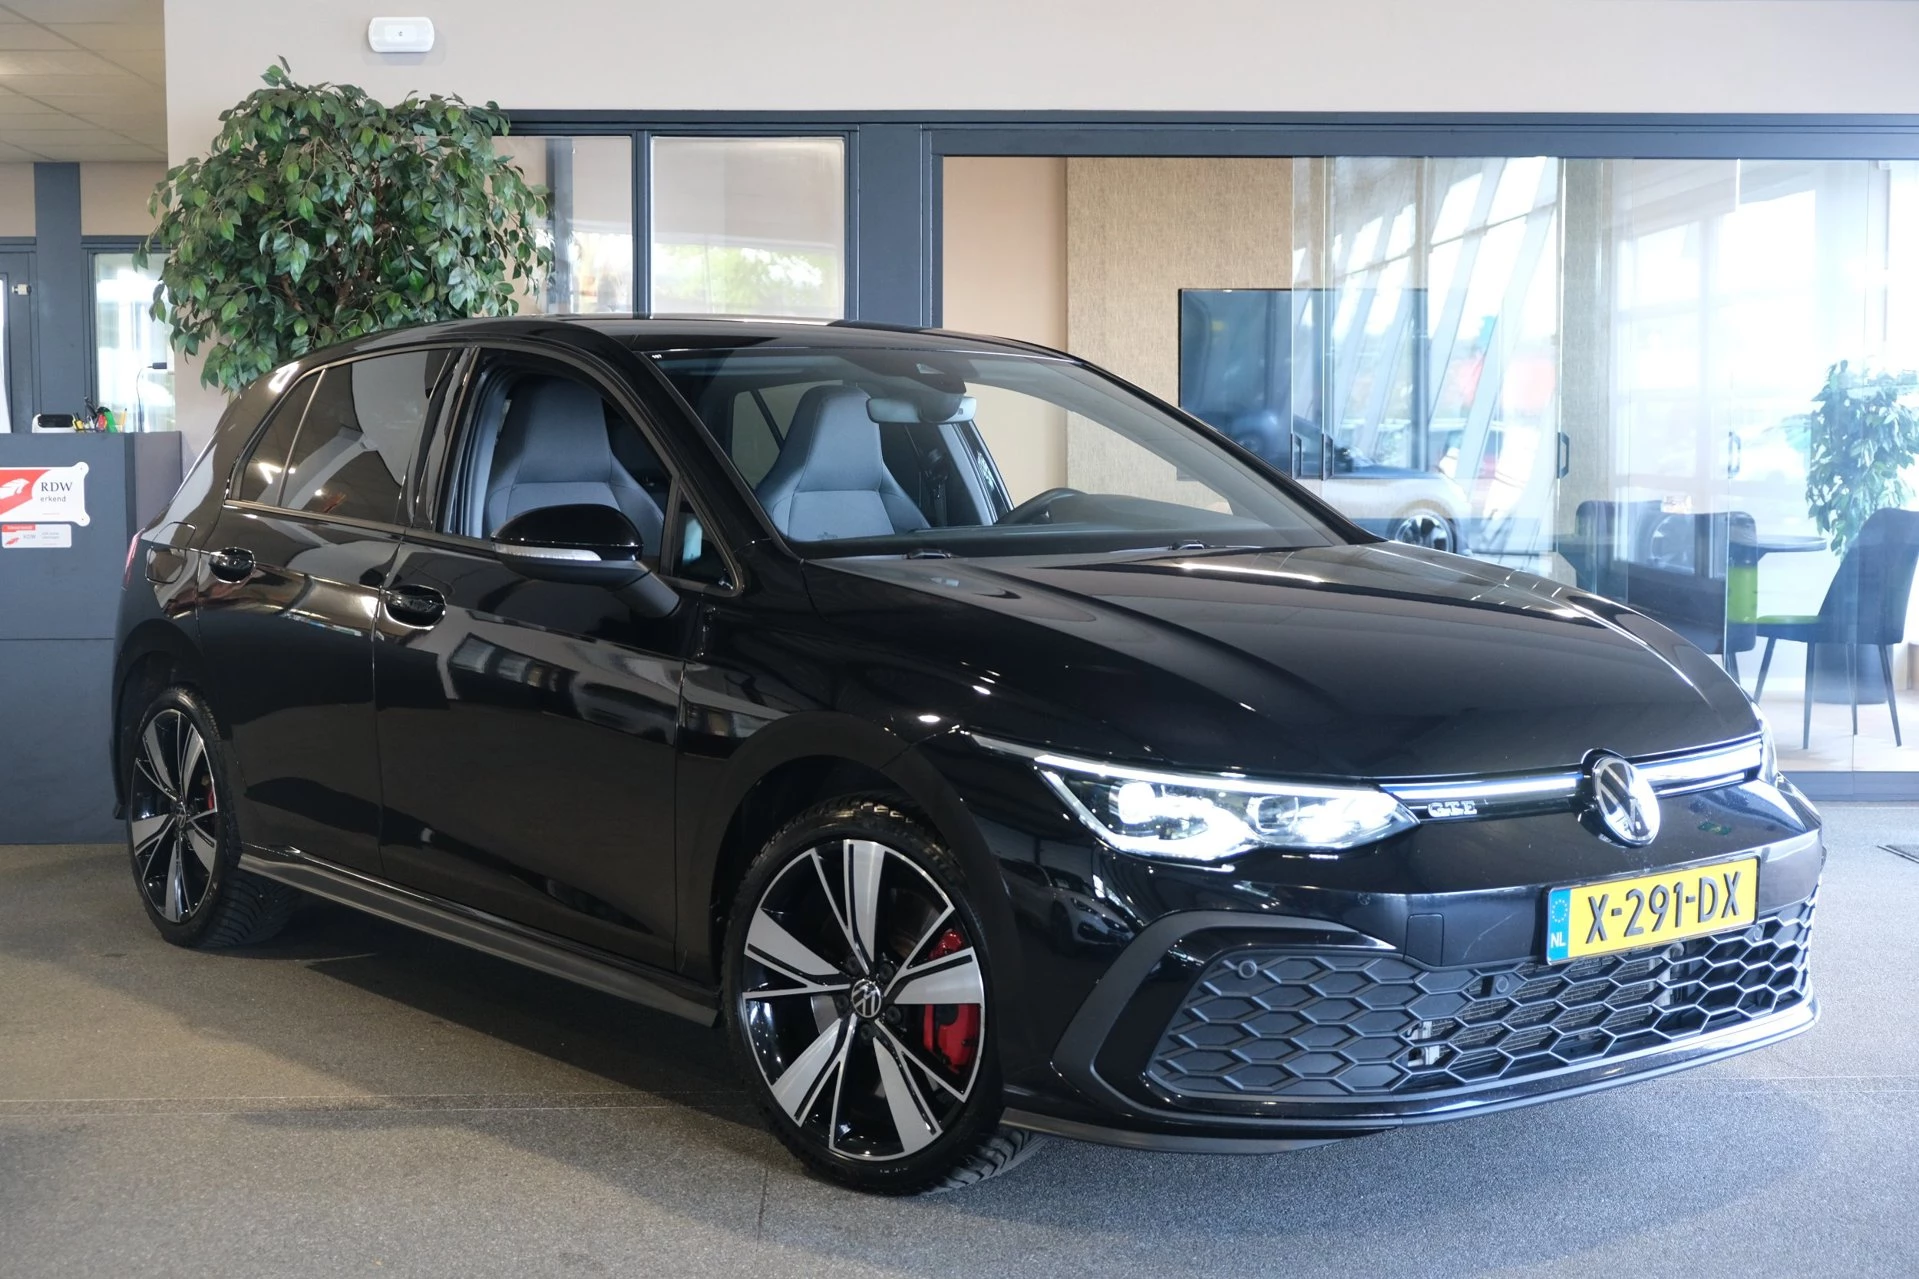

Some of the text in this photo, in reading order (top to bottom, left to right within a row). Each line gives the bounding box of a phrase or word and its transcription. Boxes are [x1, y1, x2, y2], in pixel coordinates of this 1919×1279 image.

[41, 481, 73, 492] RDW
[40, 495, 67, 503] erkend
[1428, 800, 1478, 817] GTE
[1585, 871, 1742, 945] X-291-DX
[1550, 931, 1567, 948] NL
